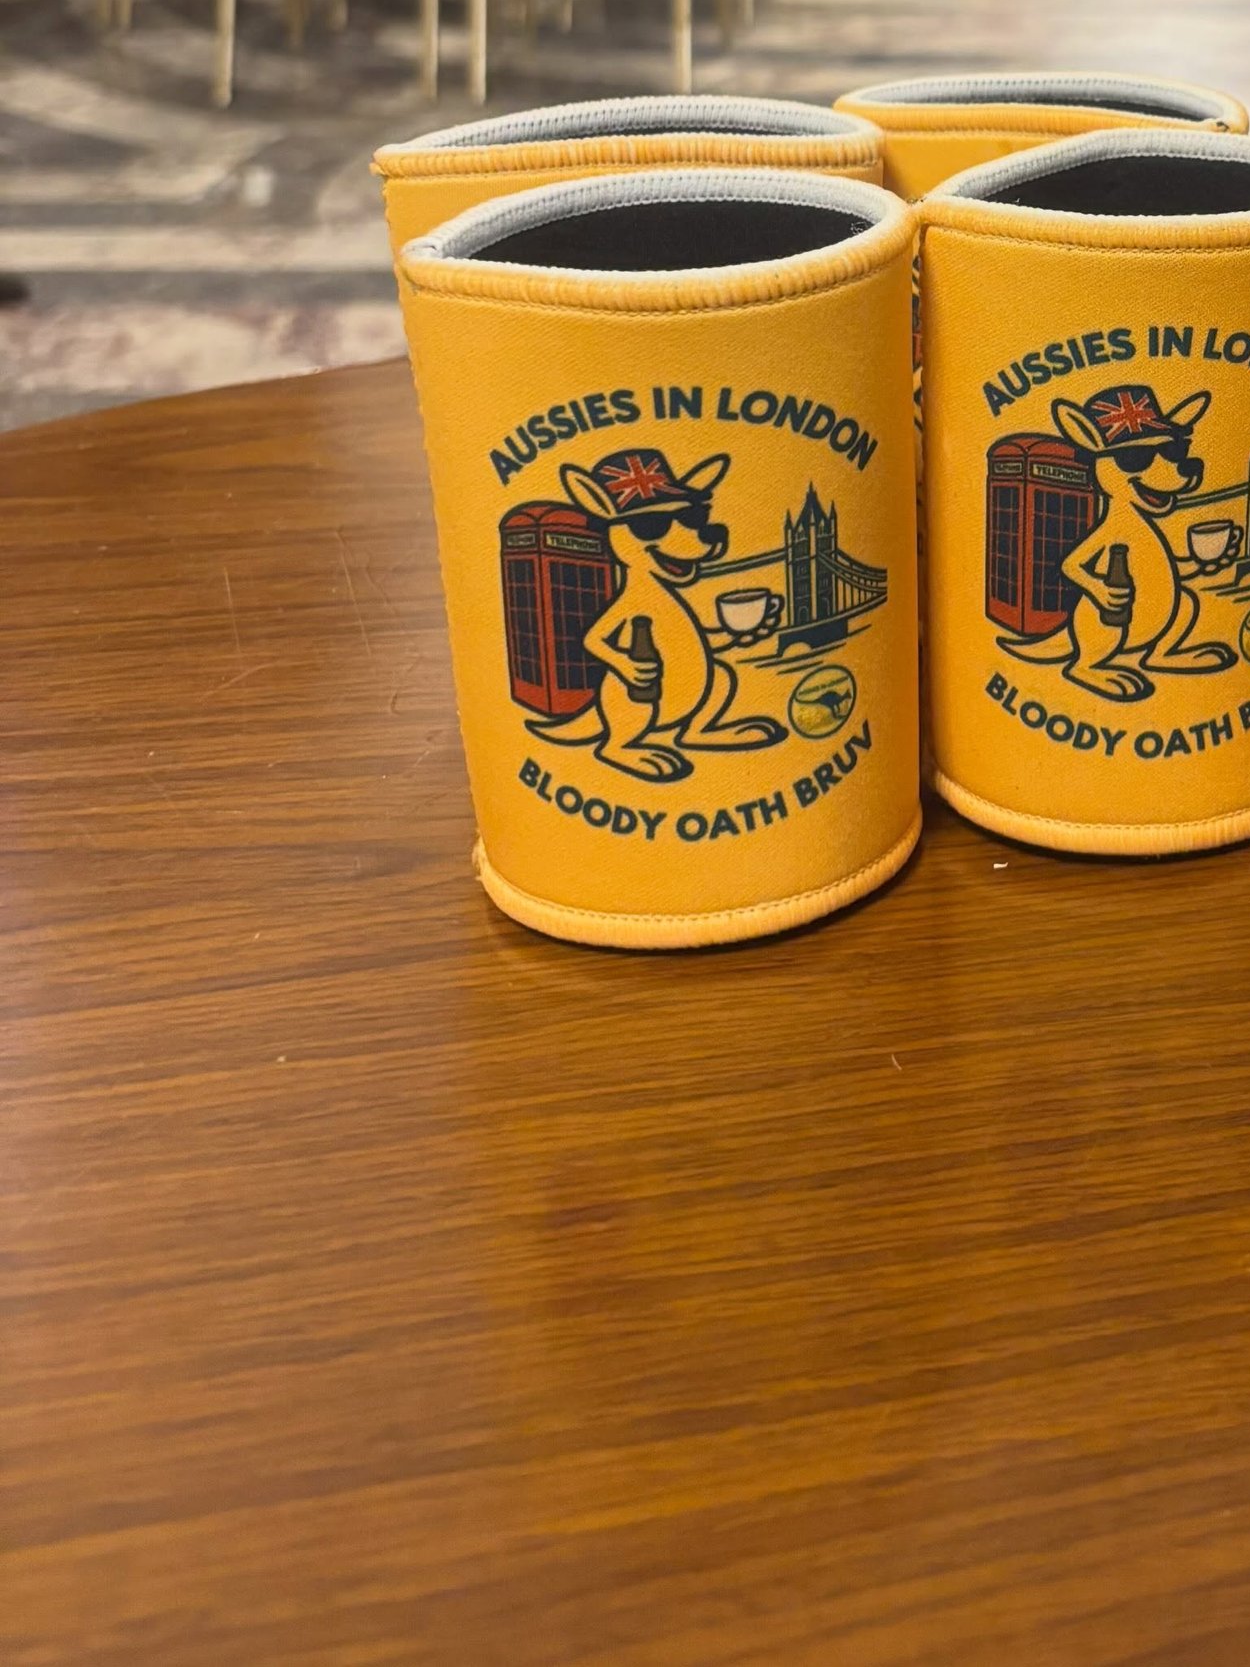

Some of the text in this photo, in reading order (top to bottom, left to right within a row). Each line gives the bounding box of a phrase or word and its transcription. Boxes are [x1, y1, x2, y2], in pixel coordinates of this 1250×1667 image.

[983, 328, 1137, 418] AUSSIES
[1148, 326, 1194, 357] IN
[490, 386, 879, 486] AUSSIES IN LONDON
[985, 671, 1126, 756] BLOODY
[1134, 713, 1233, 759] OATH
[519, 718, 872, 842] BLOODY OATH BRUV
